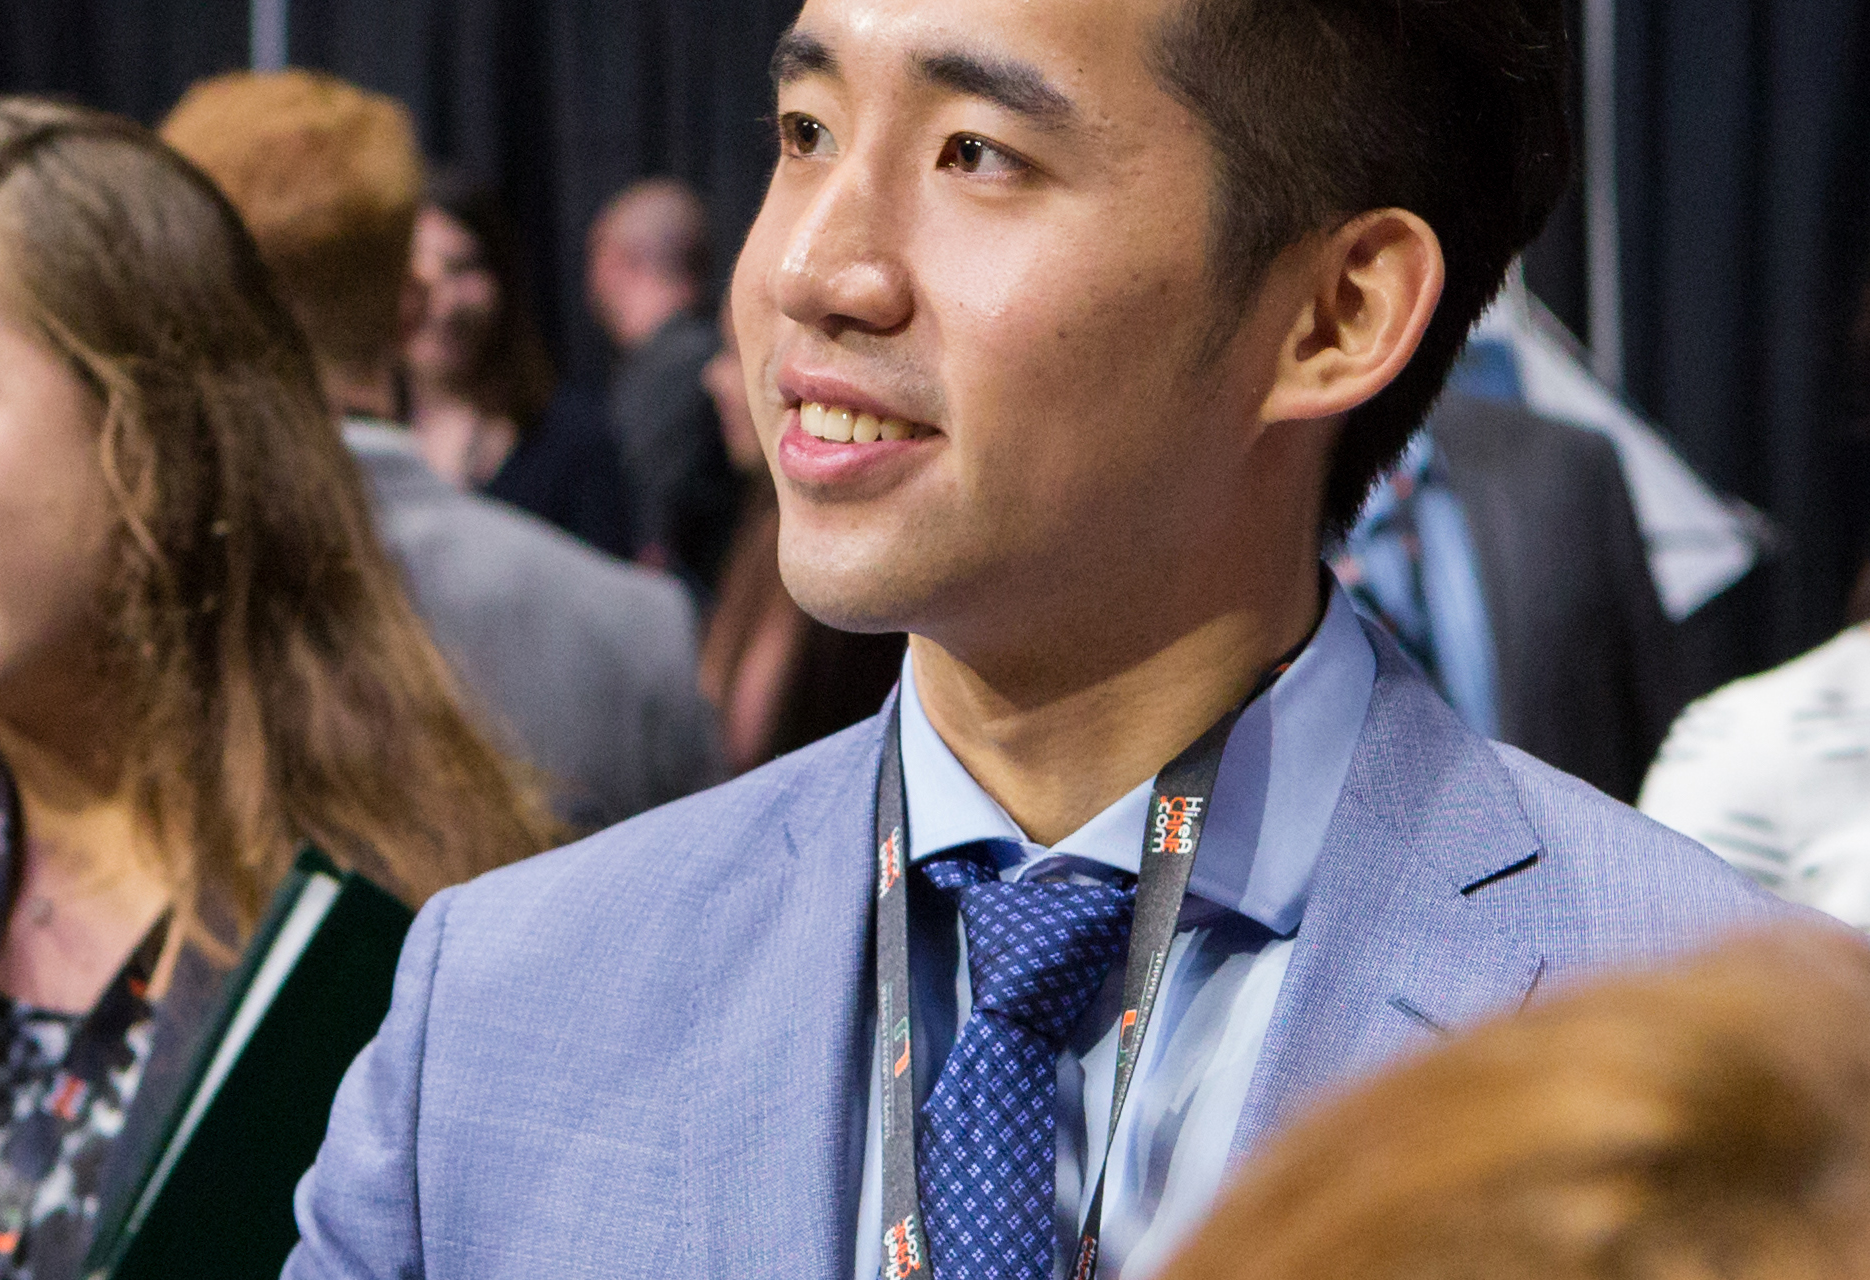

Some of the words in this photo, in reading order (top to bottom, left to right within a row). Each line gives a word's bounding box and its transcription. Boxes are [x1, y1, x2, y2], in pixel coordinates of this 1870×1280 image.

[1152, 795, 1170, 853] .com
[1162, 797, 1187, 853] CANE
[1176, 797, 1203, 854] HireA
[894, 1219, 912, 1279] CANE
[905, 1215, 921, 1271] .com
